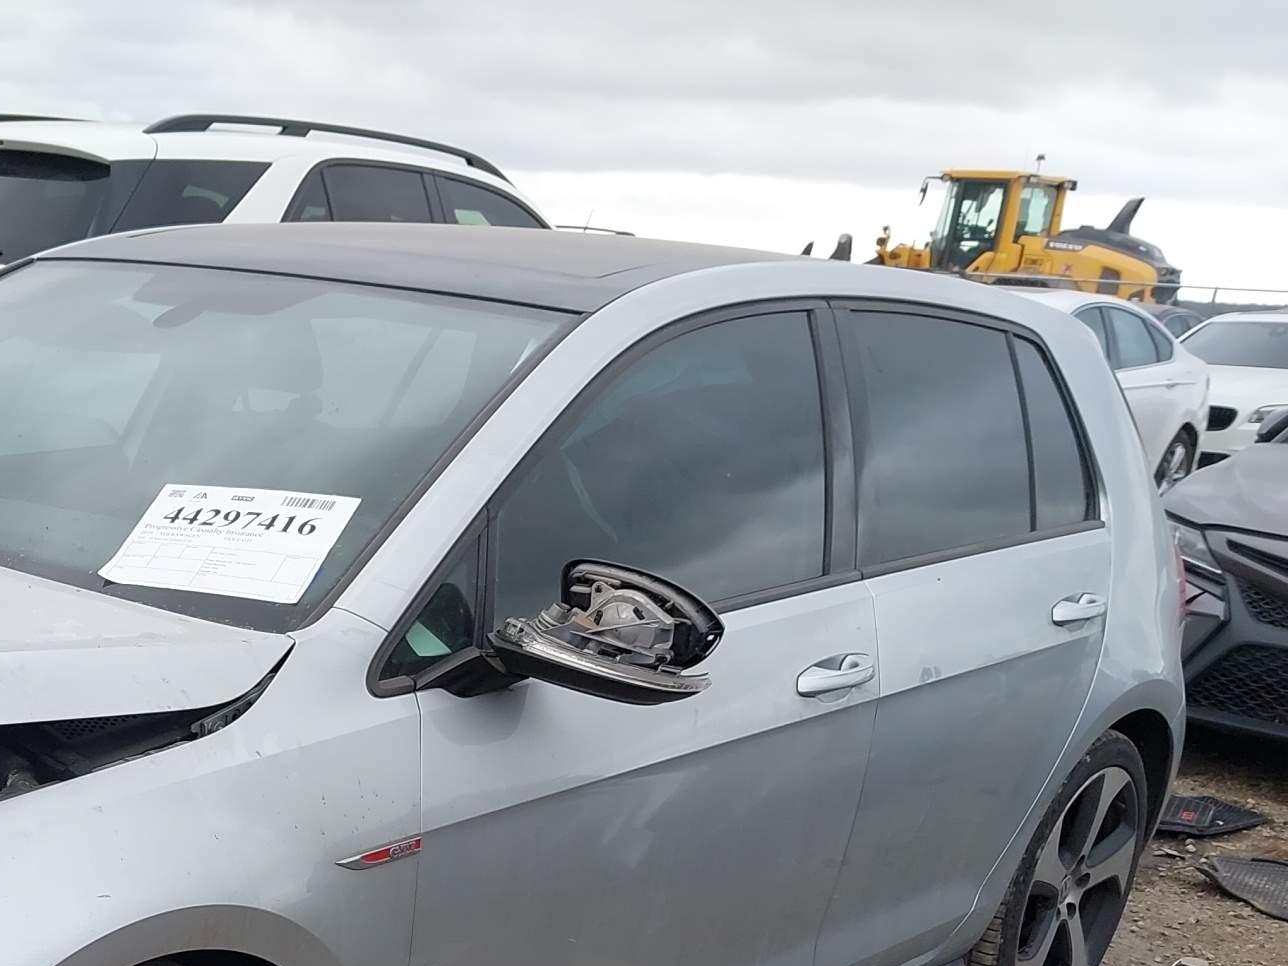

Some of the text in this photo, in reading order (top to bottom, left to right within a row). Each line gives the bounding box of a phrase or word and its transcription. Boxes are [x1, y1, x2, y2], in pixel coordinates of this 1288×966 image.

[144, 523, 264, 538] Progressive Casualty Insurance
[163, 506, 324, 536] 44297416
